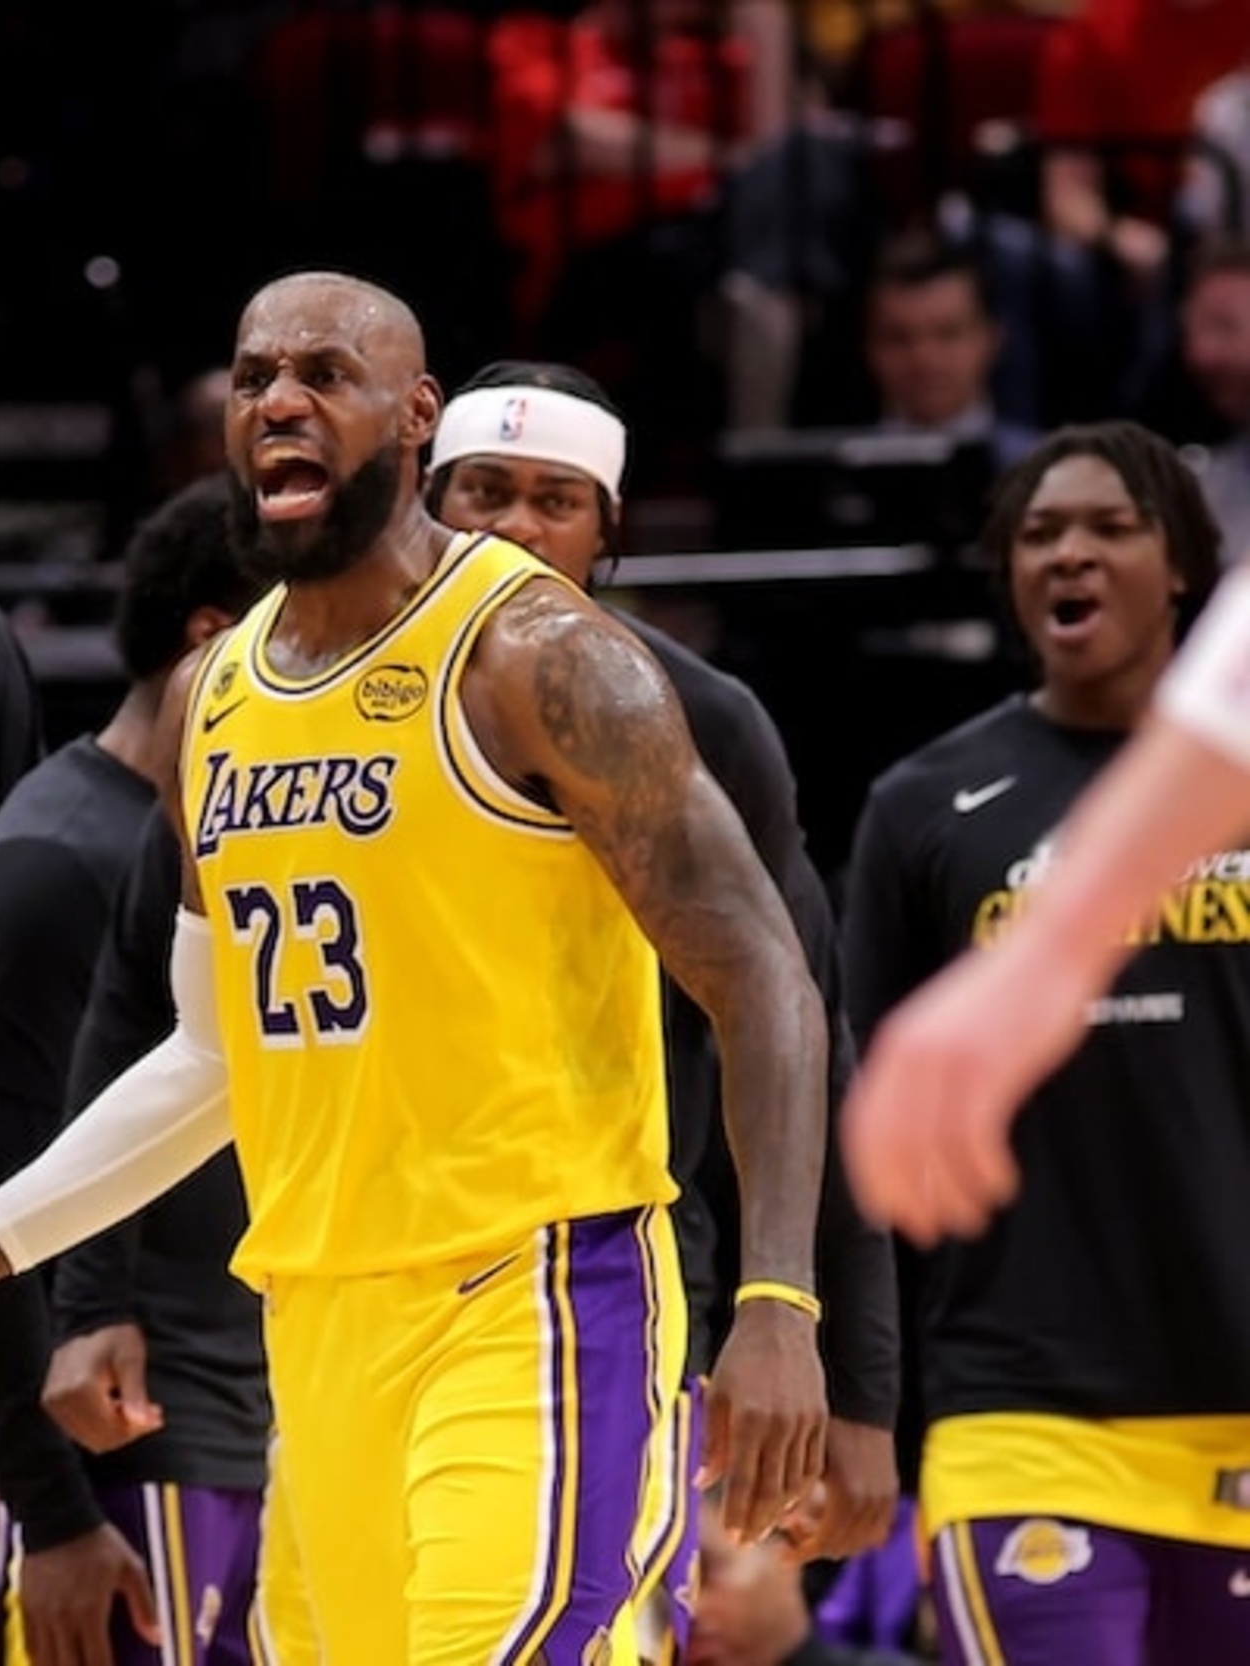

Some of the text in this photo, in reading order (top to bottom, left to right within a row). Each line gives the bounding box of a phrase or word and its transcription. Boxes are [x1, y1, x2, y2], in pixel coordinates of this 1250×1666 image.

[362, 678, 424, 706] bibigo
[195, 750, 398, 858] LAKERS
[223, 878, 370, 1044] 23
